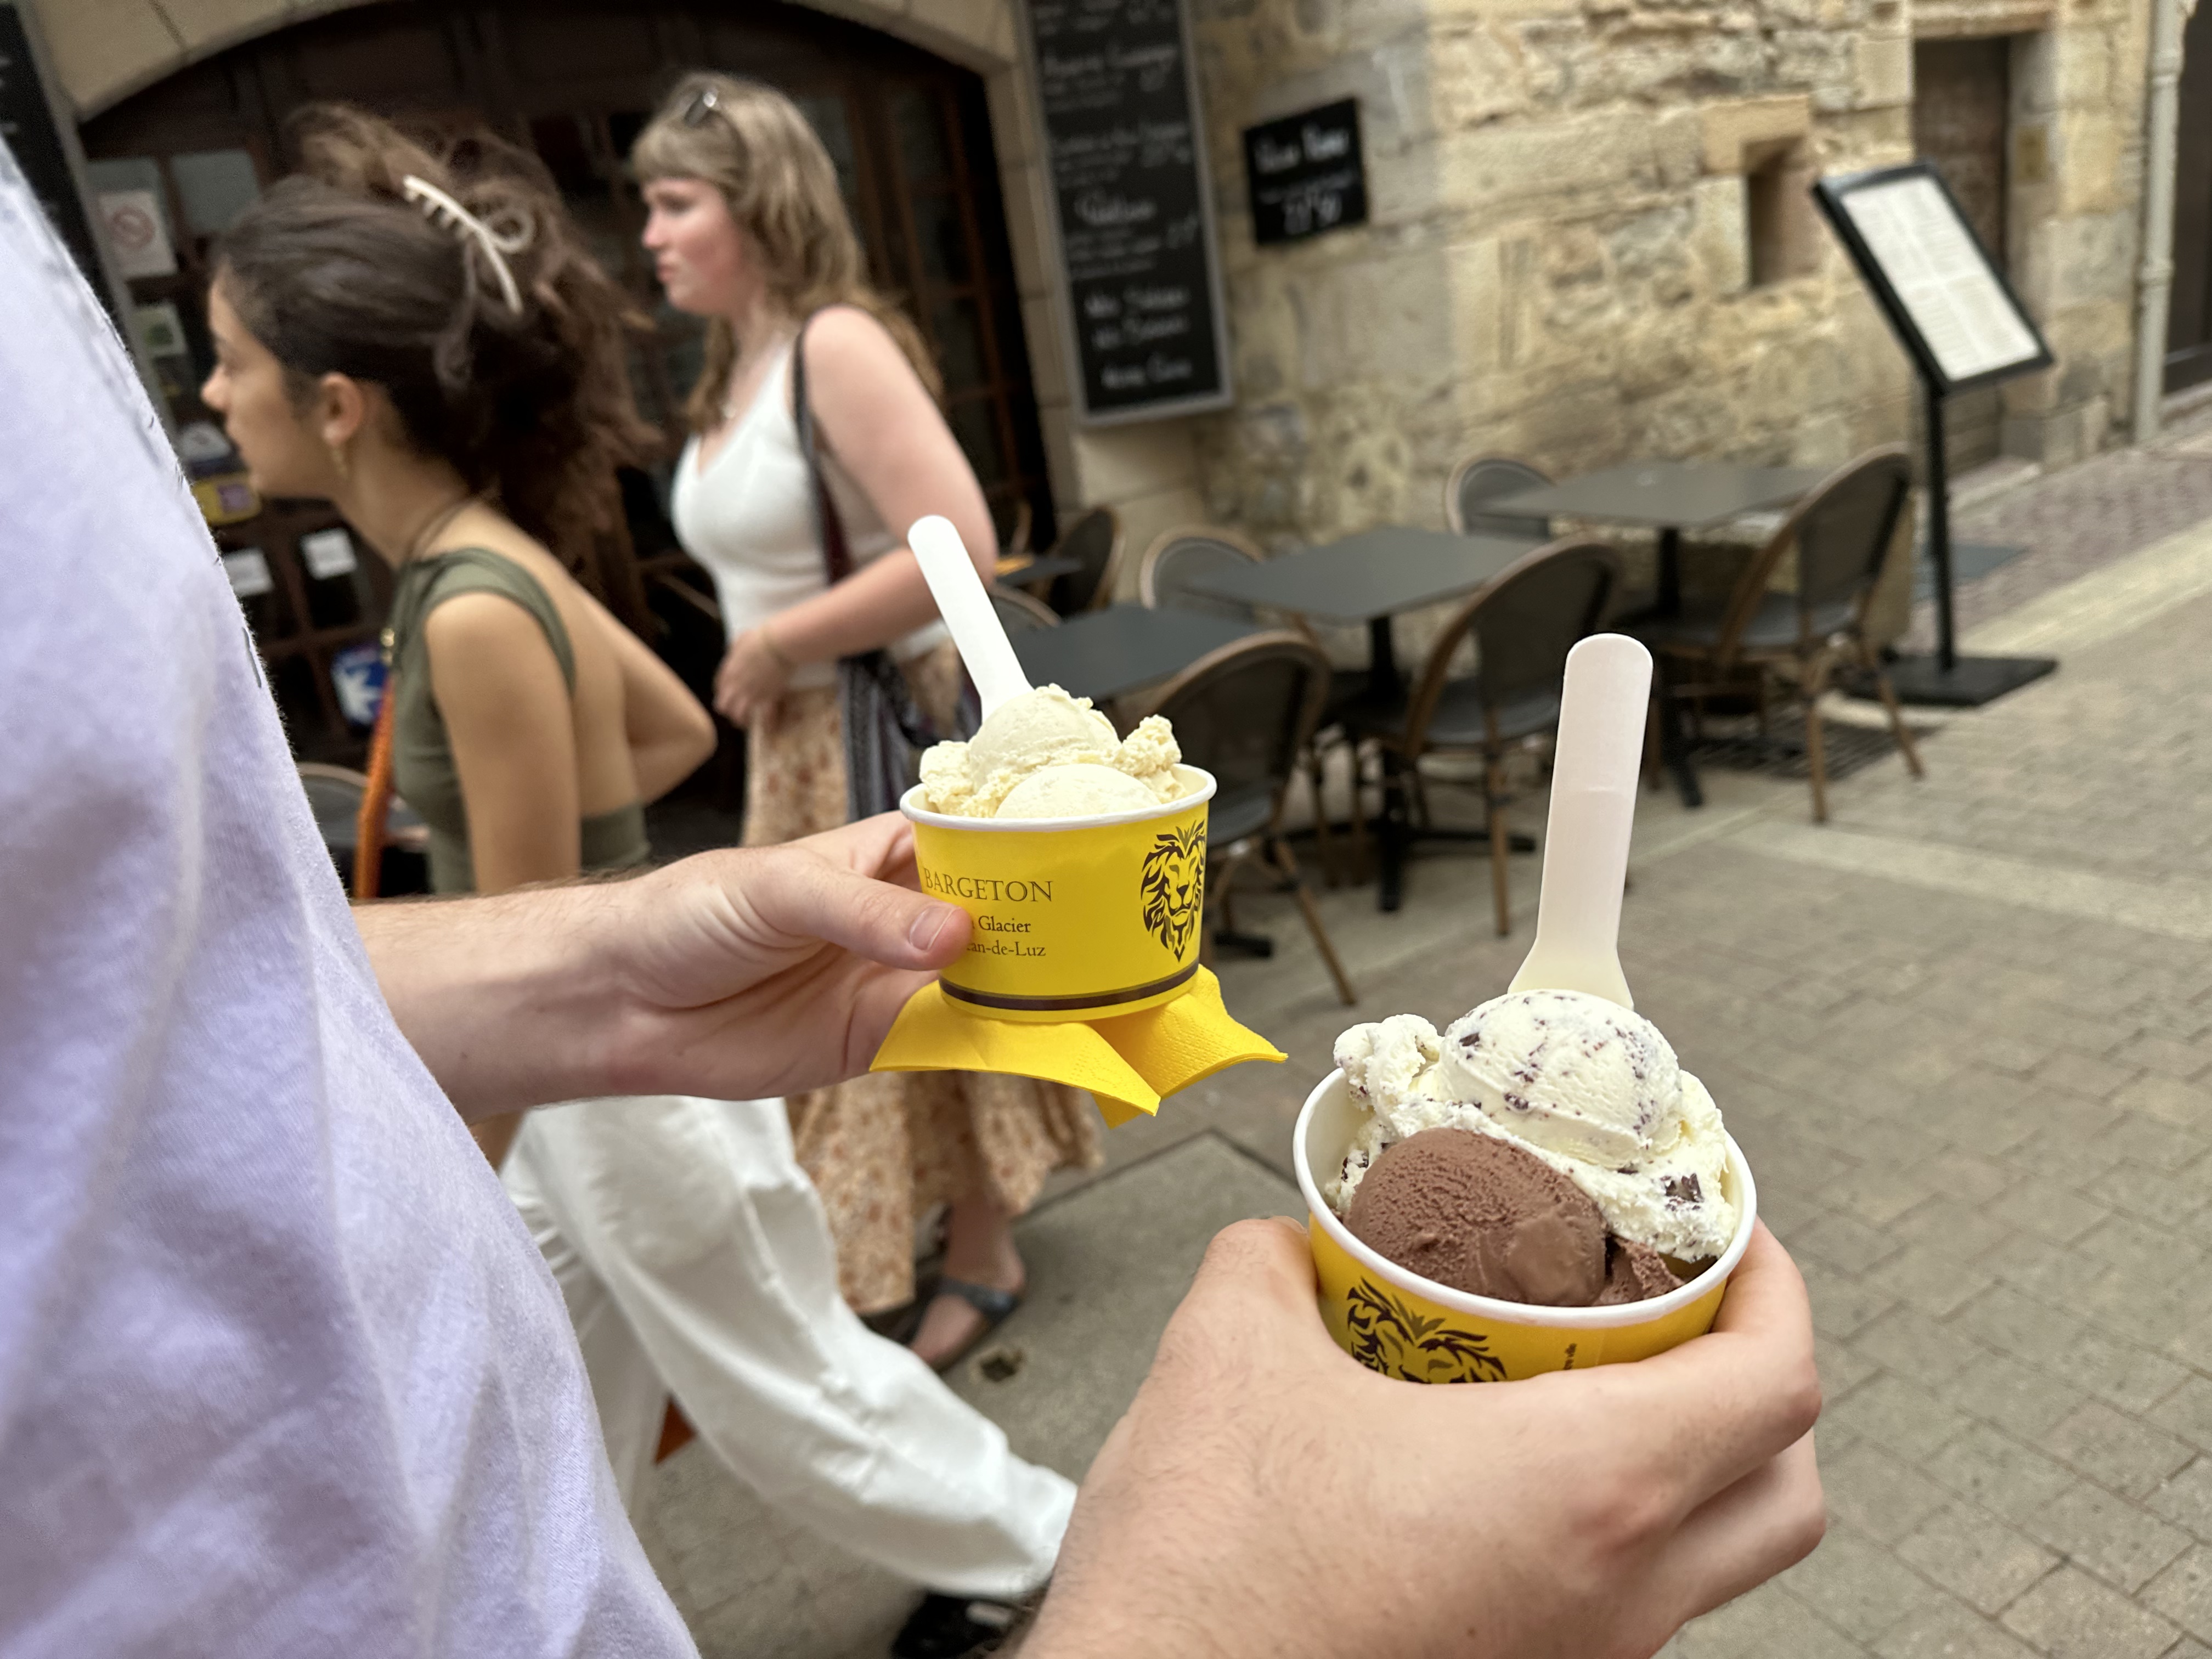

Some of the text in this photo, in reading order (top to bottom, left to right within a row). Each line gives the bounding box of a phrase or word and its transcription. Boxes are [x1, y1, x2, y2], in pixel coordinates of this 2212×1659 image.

[923, 866, 1053, 902] BARGETON
[978, 915, 1031, 933] Glacier
[967, 940, 1046, 956] an-de-Luz
